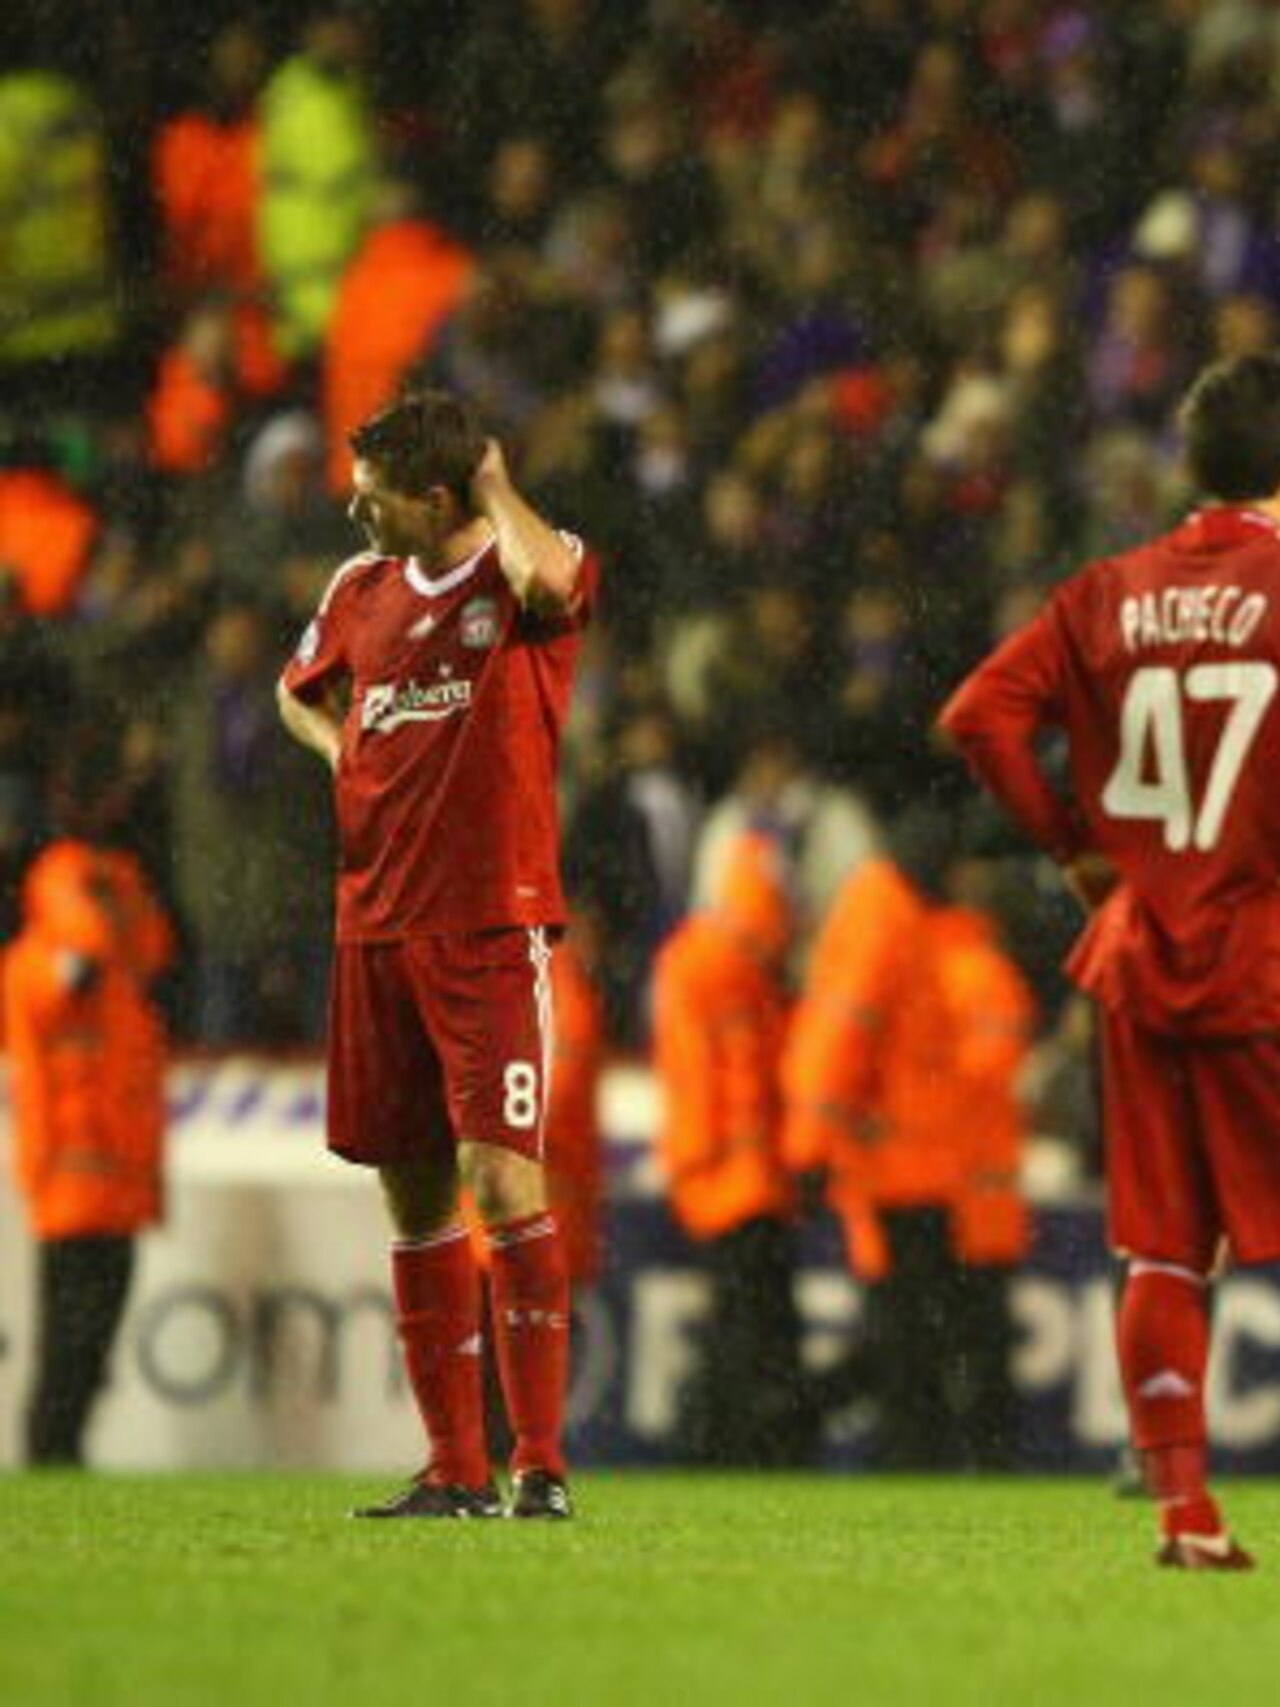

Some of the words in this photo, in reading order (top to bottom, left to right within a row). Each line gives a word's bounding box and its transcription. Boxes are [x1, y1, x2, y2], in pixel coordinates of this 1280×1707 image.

[1121, 584, 1268, 652] PACHECO
[1102, 661, 1279, 853] 47
[503, 1061, 536, 1128] 8
